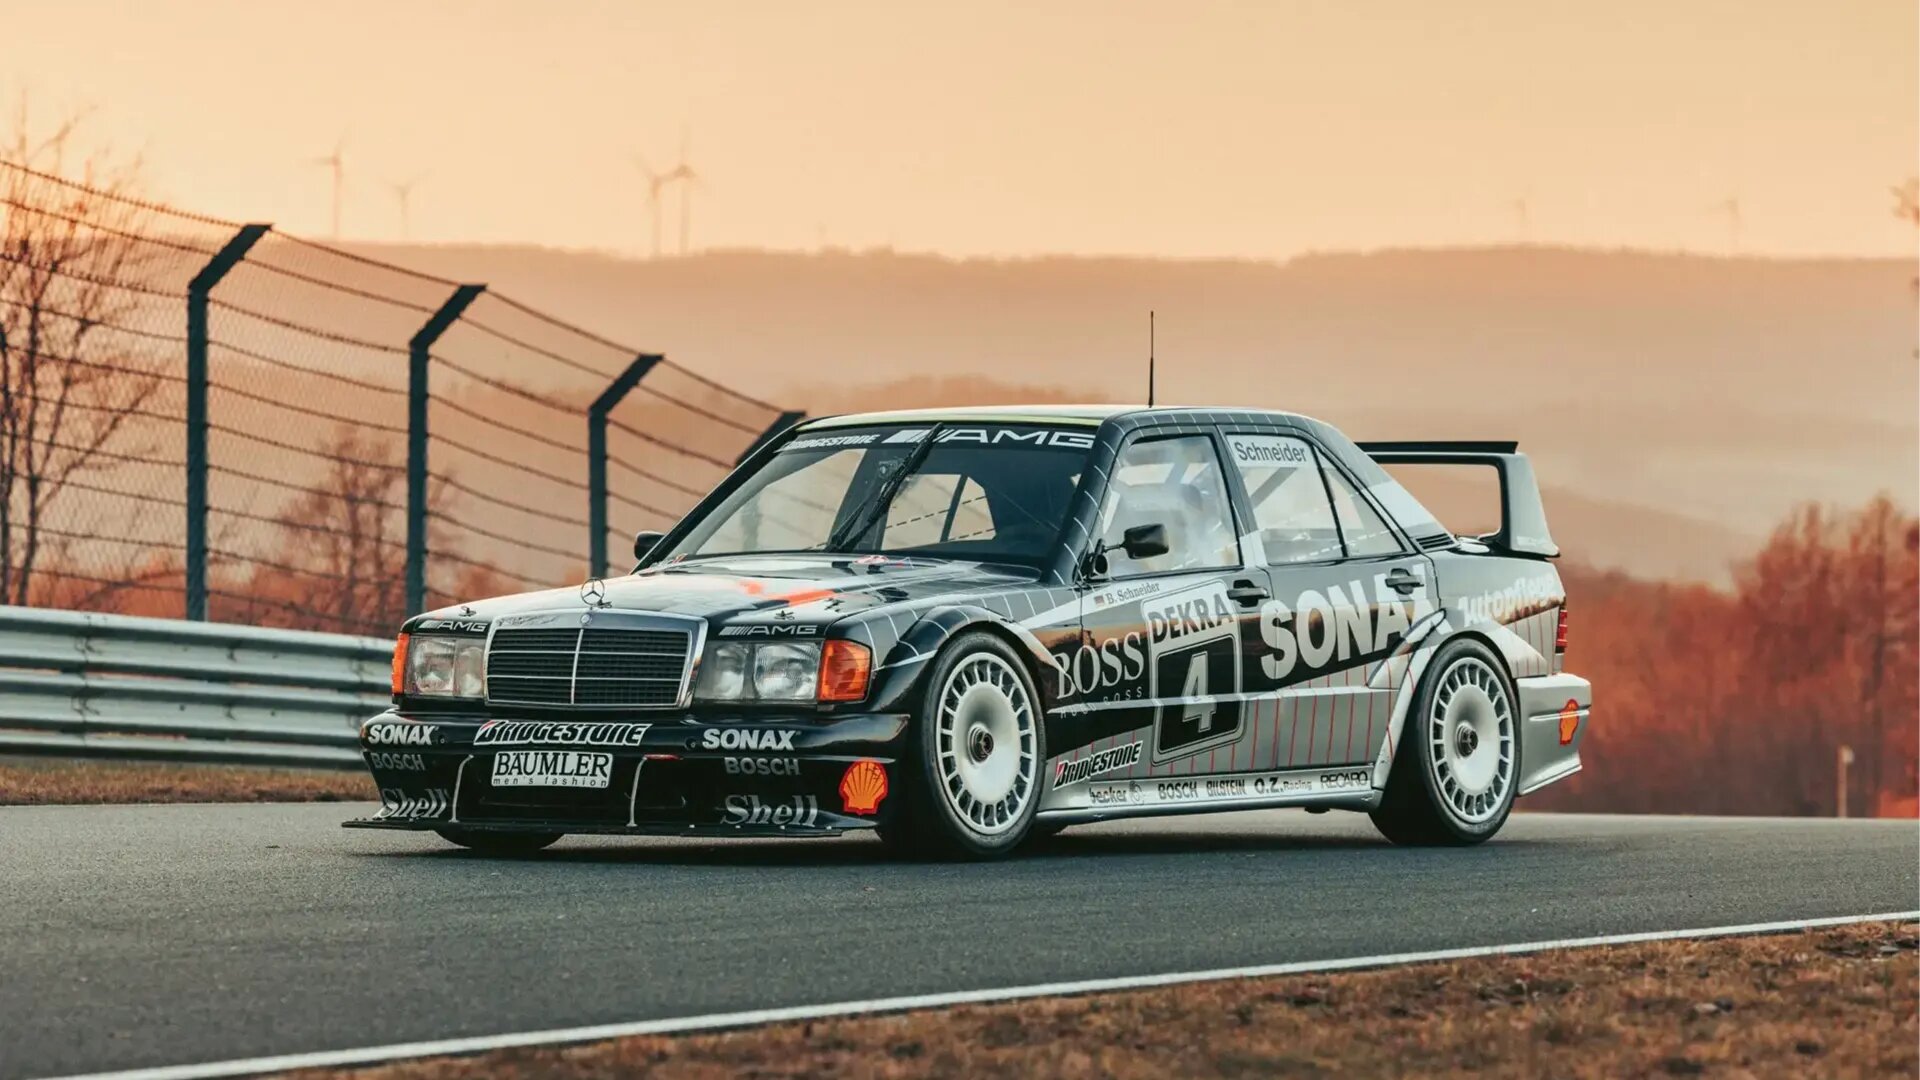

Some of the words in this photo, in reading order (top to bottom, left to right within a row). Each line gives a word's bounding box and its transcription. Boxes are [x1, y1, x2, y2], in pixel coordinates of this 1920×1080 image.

[937, 428, 1096, 449] AMG
[1234, 441, 1307, 462] Schneider
[1105, 592, 1118, 605] B.
[1117, 582, 1160, 602] Schneider
[437, 620, 488, 632] AMG
[1147, 593, 1234, 644] DEKRA
[747, 624, 818, 636] AMG
[1053, 631, 1145, 700] BOSS
[1181, 650, 1217, 733] 4
[367, 724, 436, 745] SONAX
[473, 719, 653, 746] BRIDGESTONE
[702, 728, 796, 751] SONAX
[370, 752, 426, 771] BOSCH
[495, 752, 609, 778] BÄUMLER
[724, 757, 800, 776] BOSCH
[544, 776, 607, 787] fashion
[1158, 781, 1198, 800] BOSCH
[1206, 778, 1247, 798] BILSTEIN
[1320, 770, 1369, 790] RECARO
[372, 788, 447, 818] Shell
[720, 795, 818, 827] Shell
